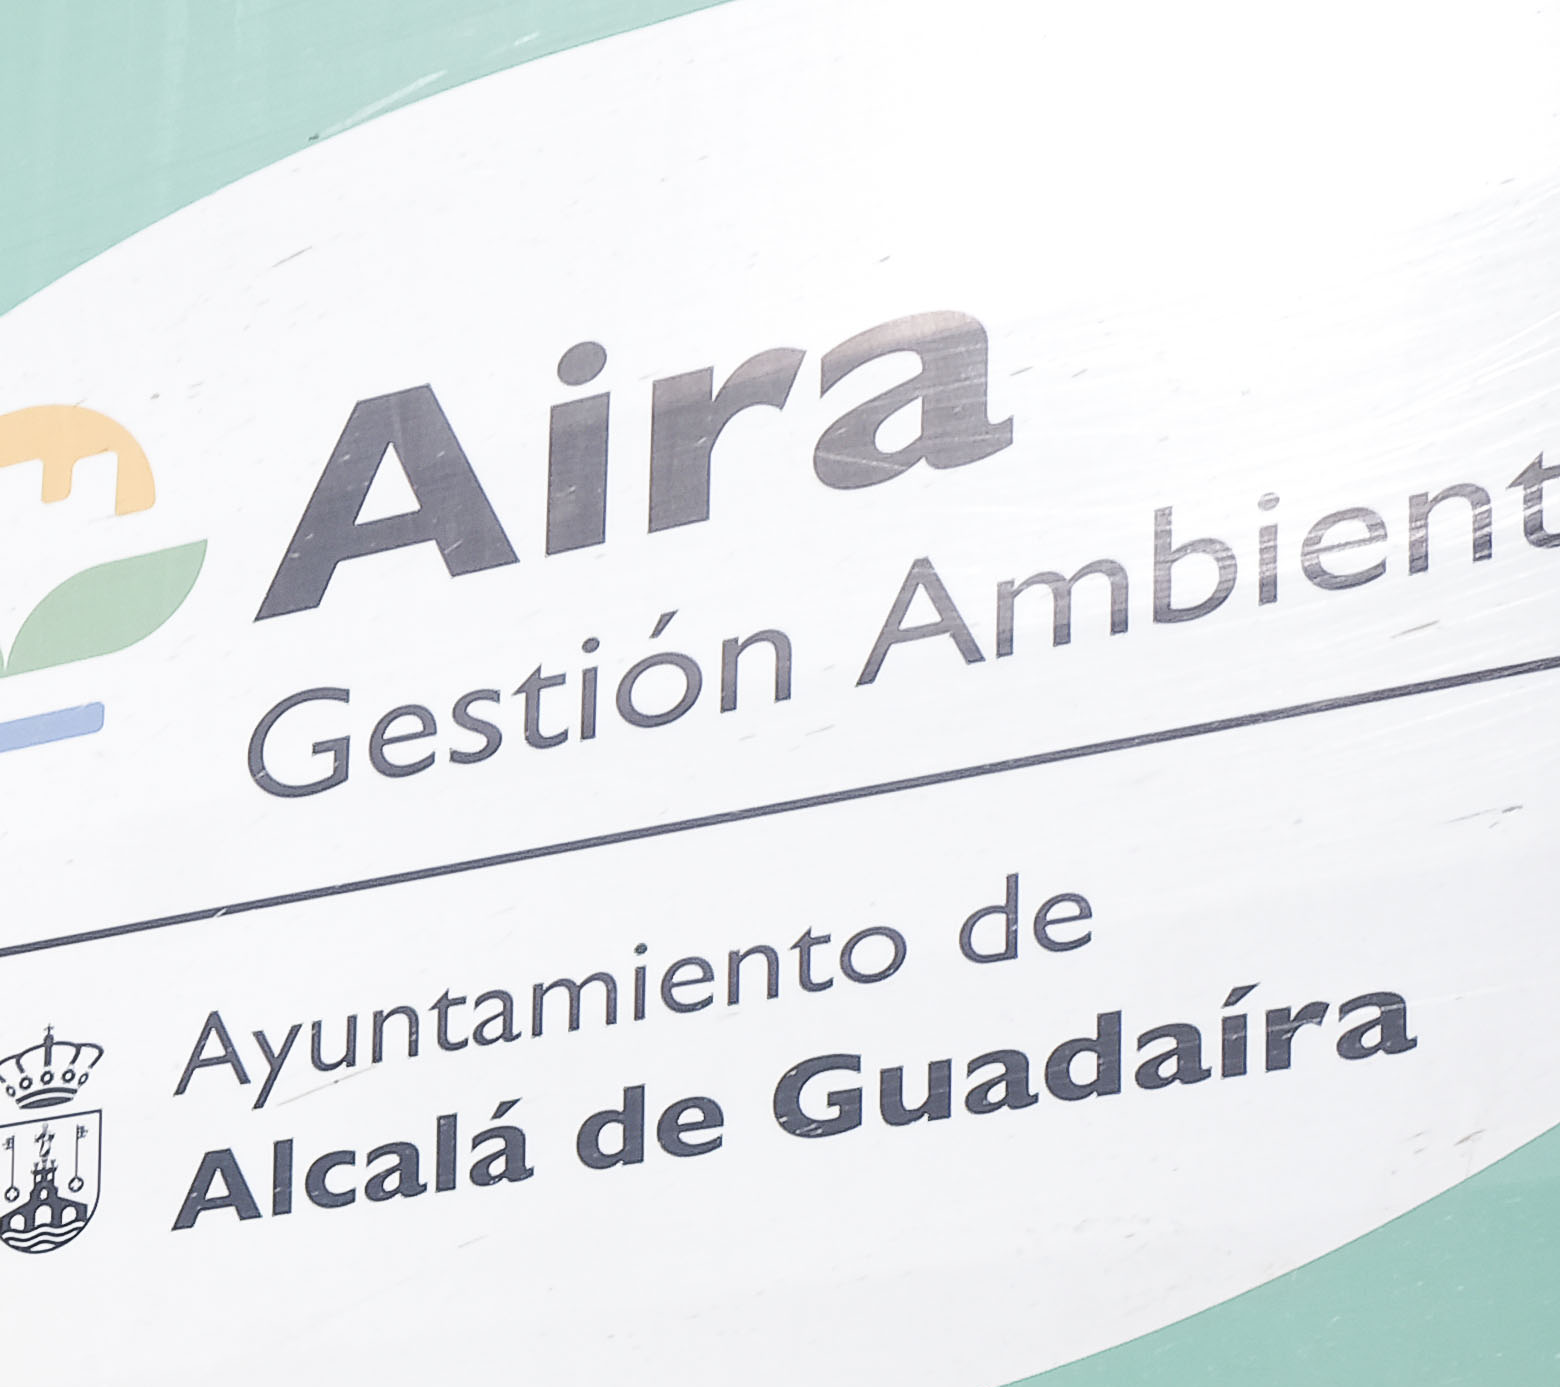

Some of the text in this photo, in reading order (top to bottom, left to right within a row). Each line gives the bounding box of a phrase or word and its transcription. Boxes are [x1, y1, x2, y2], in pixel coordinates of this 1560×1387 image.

[253, 322, 1013, 623] Aira
[248, 617, 792, 799] Gestión
[172, 984, 1417, 1231] Alcalá de Guadaíra
[174, 874, 1092, 1109] Ayuntamiento de
